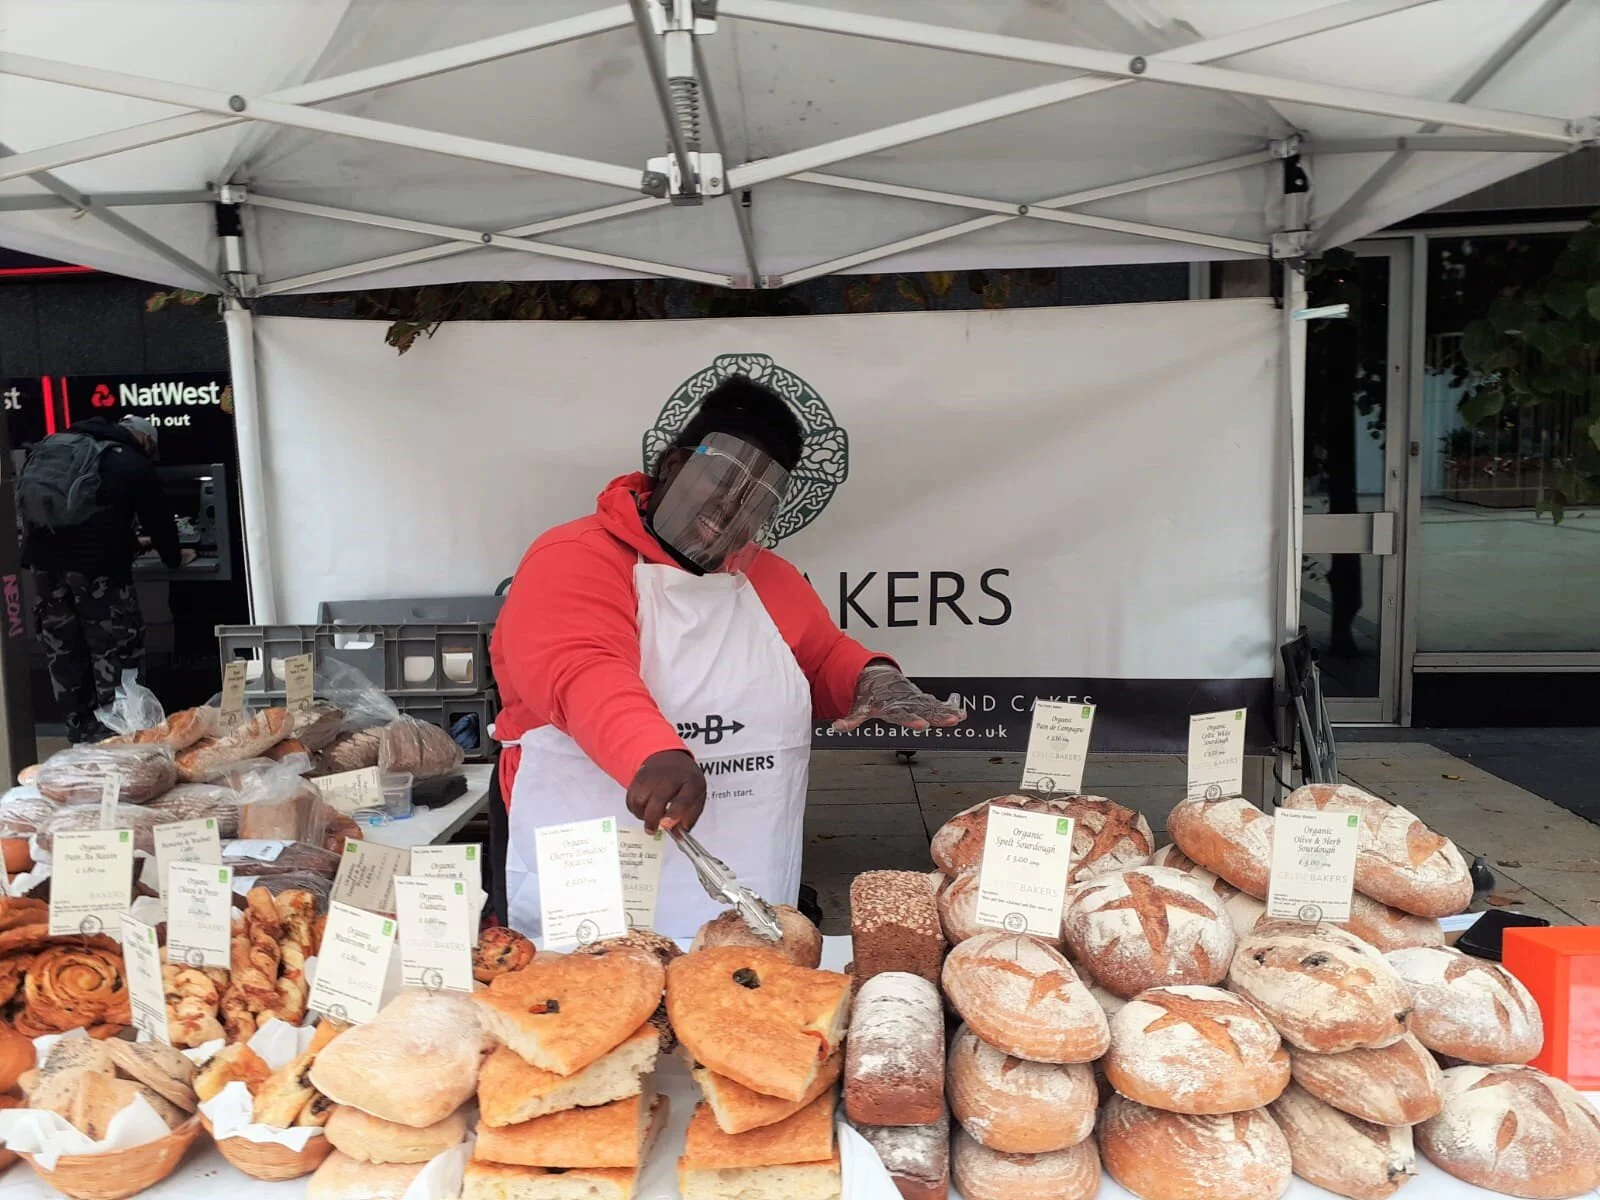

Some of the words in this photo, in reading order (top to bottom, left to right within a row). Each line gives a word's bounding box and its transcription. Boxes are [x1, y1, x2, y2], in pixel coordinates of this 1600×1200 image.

[118, 381, 220, 407] NatWest
[163, 414, 191, 427] out
[804, 568, 1012, 629] KERS
[711, 790, 731, 799] fresh
[1013, 827, 1045, 840] Organic
[1304, 825, 1333, 837] Organic
[996, 836, 1014, 848] Spelt
[1016, 839, 1056, 856] Sourdough
[1294, 835, 1313, 844] Olive
[1314, 837, 1321, 845] &
[1321, 837, 1342, 846] Herb
[1297, 844, 1336, 856] Sourdough
